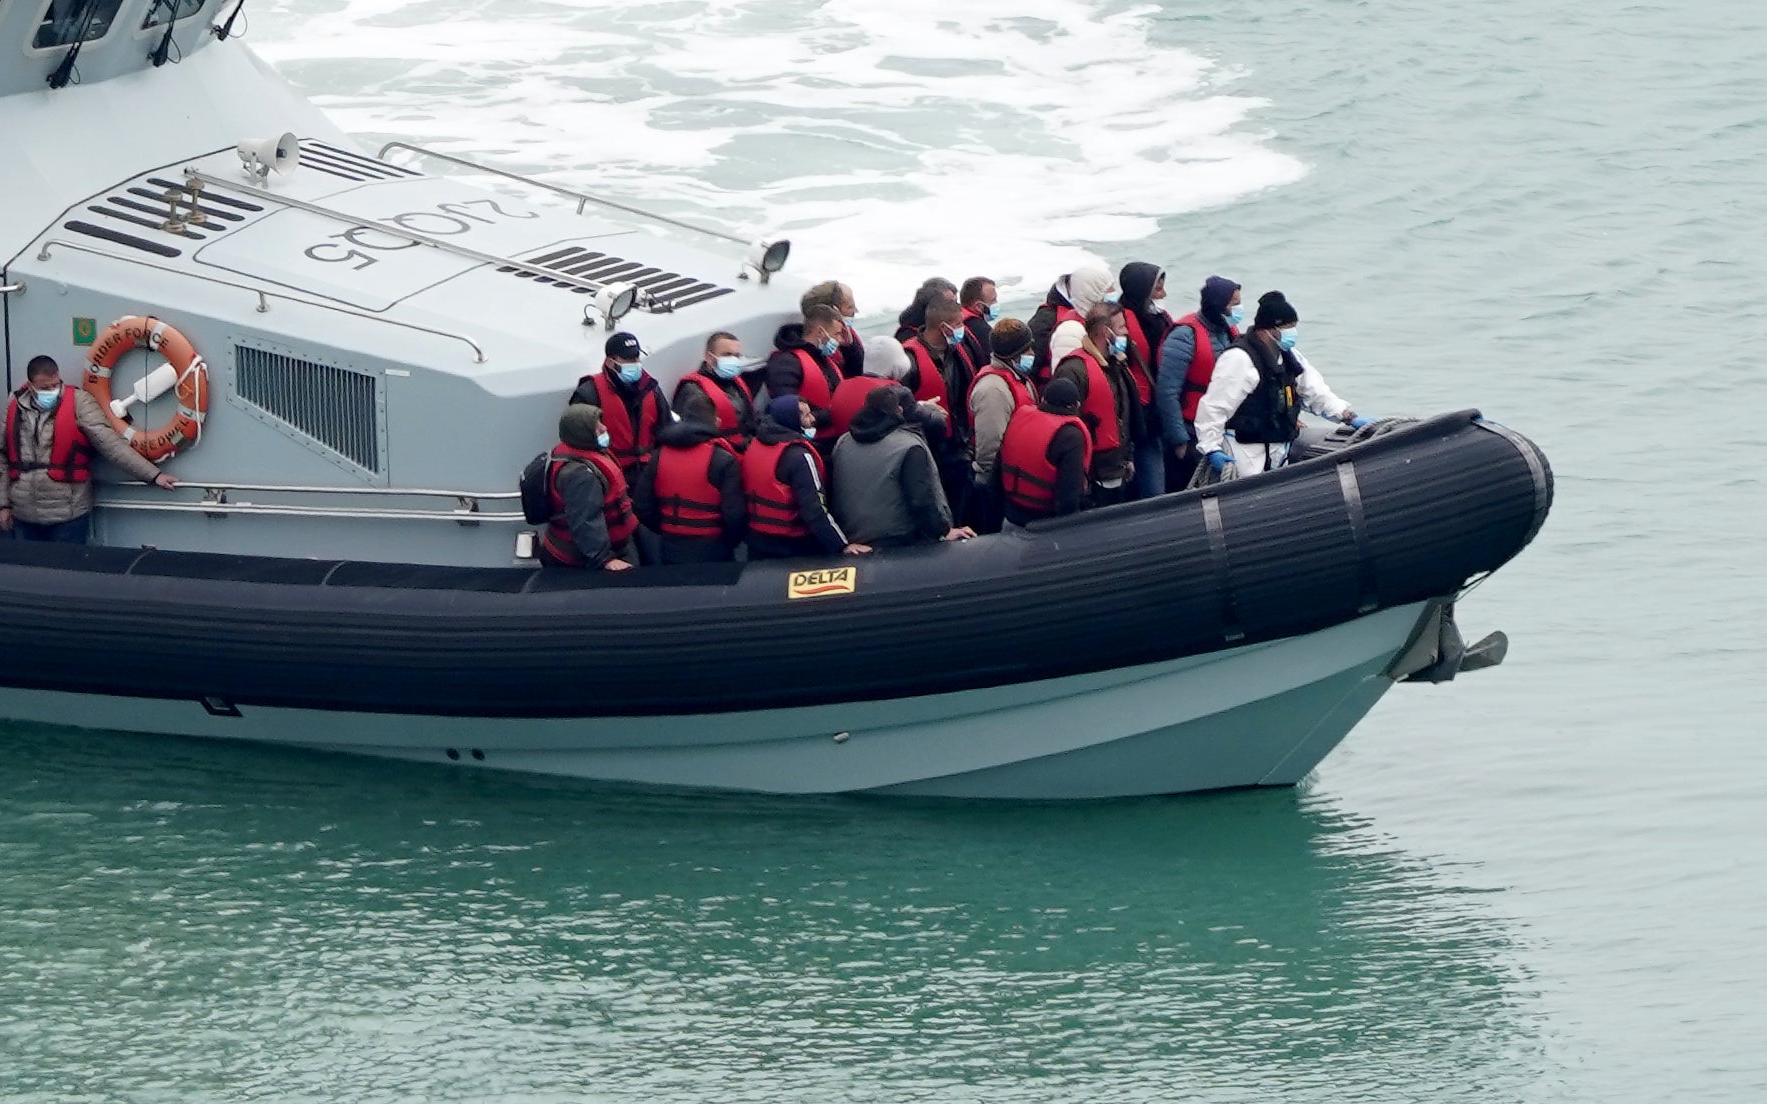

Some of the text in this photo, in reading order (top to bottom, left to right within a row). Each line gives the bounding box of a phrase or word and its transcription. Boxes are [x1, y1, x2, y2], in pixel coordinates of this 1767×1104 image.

[88, 327, 169, 384] BORDER FORCE
[794, 569, 848, 586] DELTA
